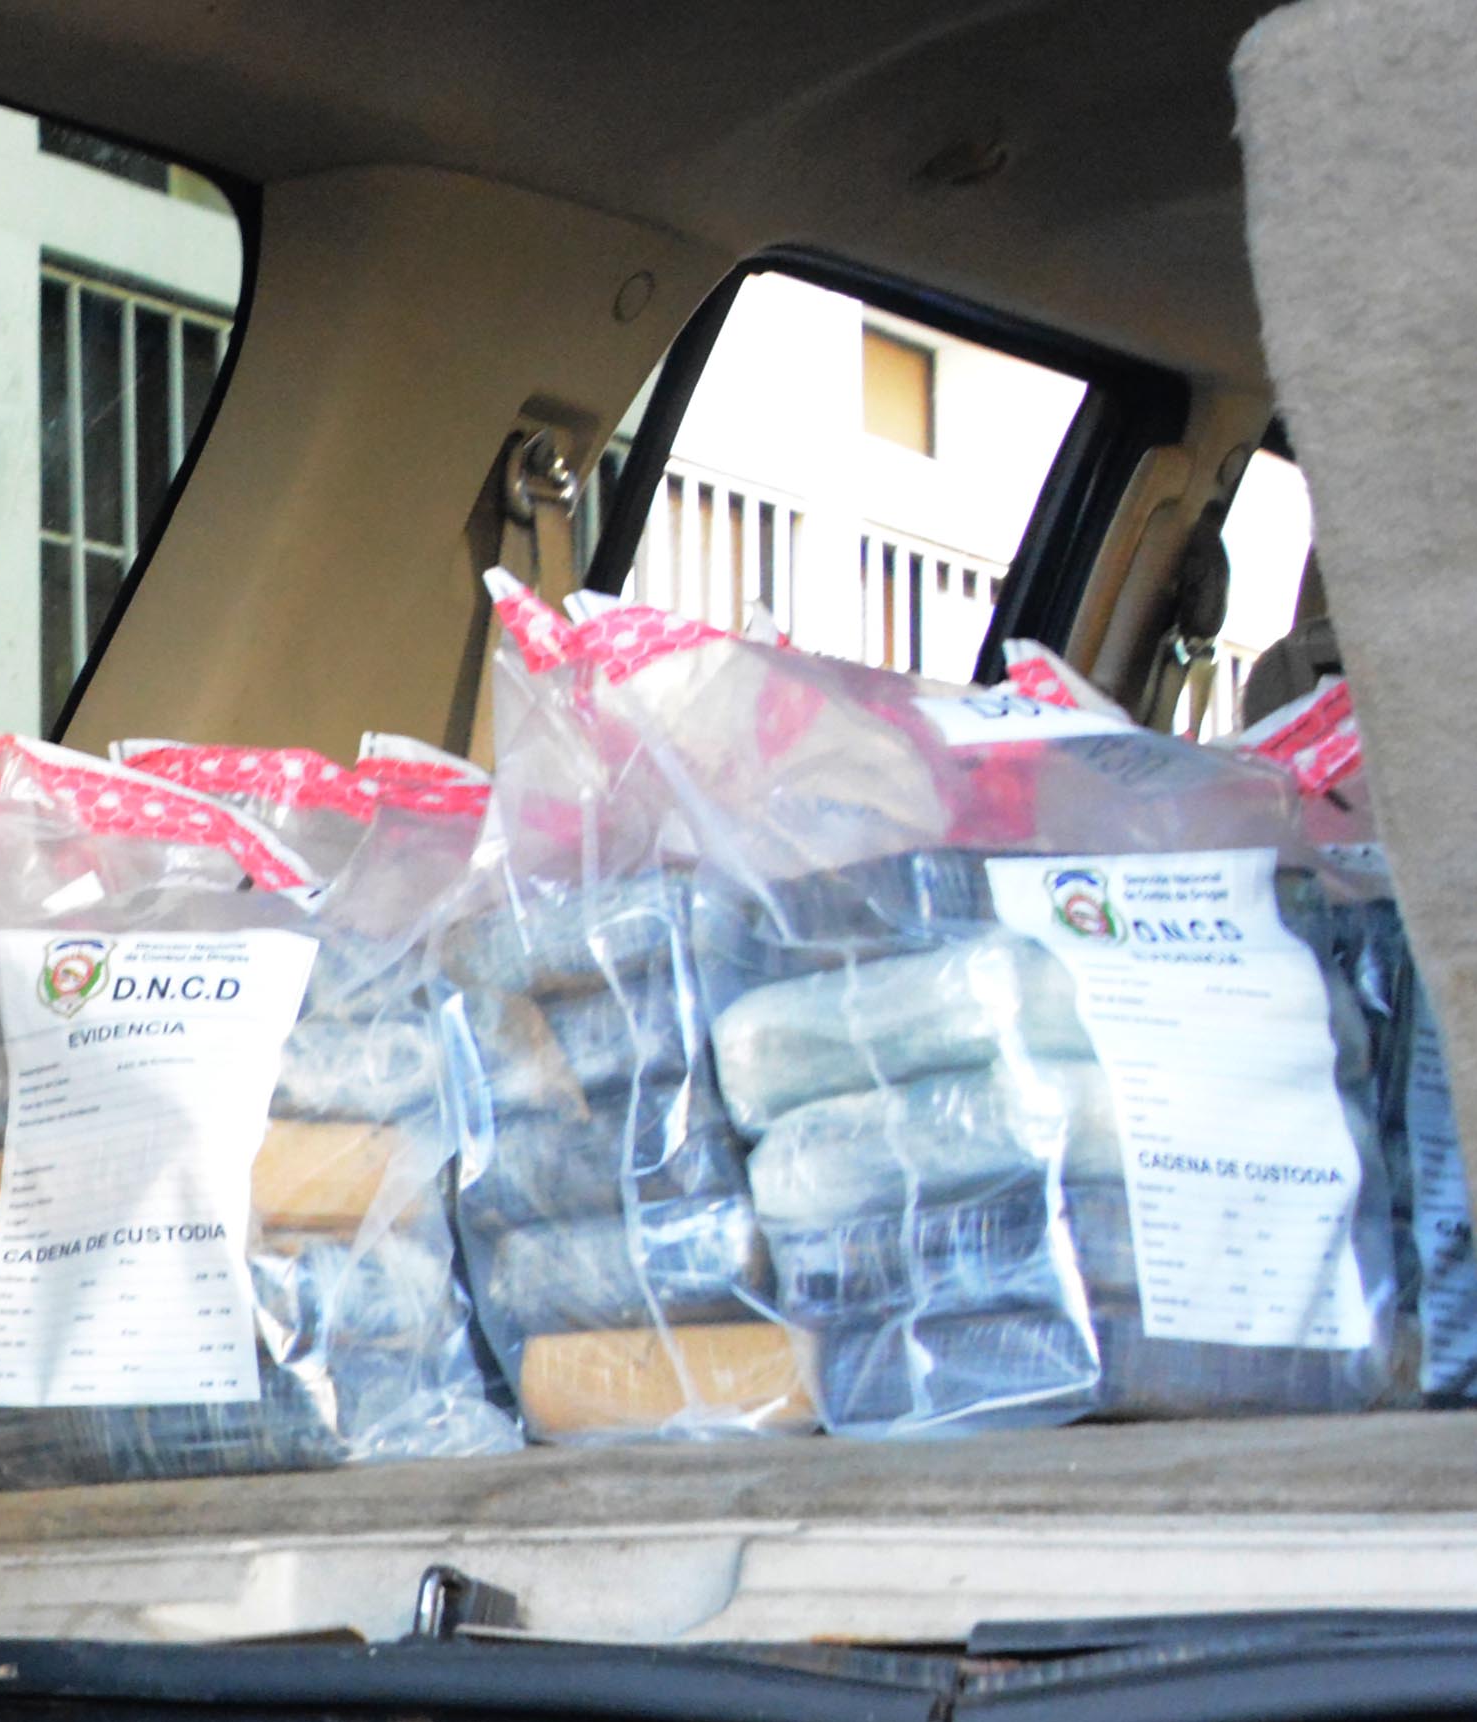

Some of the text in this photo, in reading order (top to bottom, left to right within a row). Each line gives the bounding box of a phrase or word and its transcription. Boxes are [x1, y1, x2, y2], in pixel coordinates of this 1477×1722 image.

[111, 975, 241, 1001] D.N.C.D
[68, 1021, 186, 1049] EVIDENCIA
[1138, 1151, 1212, 1174] CADENA
[1216, 1159, 1239, 1178] DE
[3, 1224, 227, 1264] CADENA DE CUSTODIA
